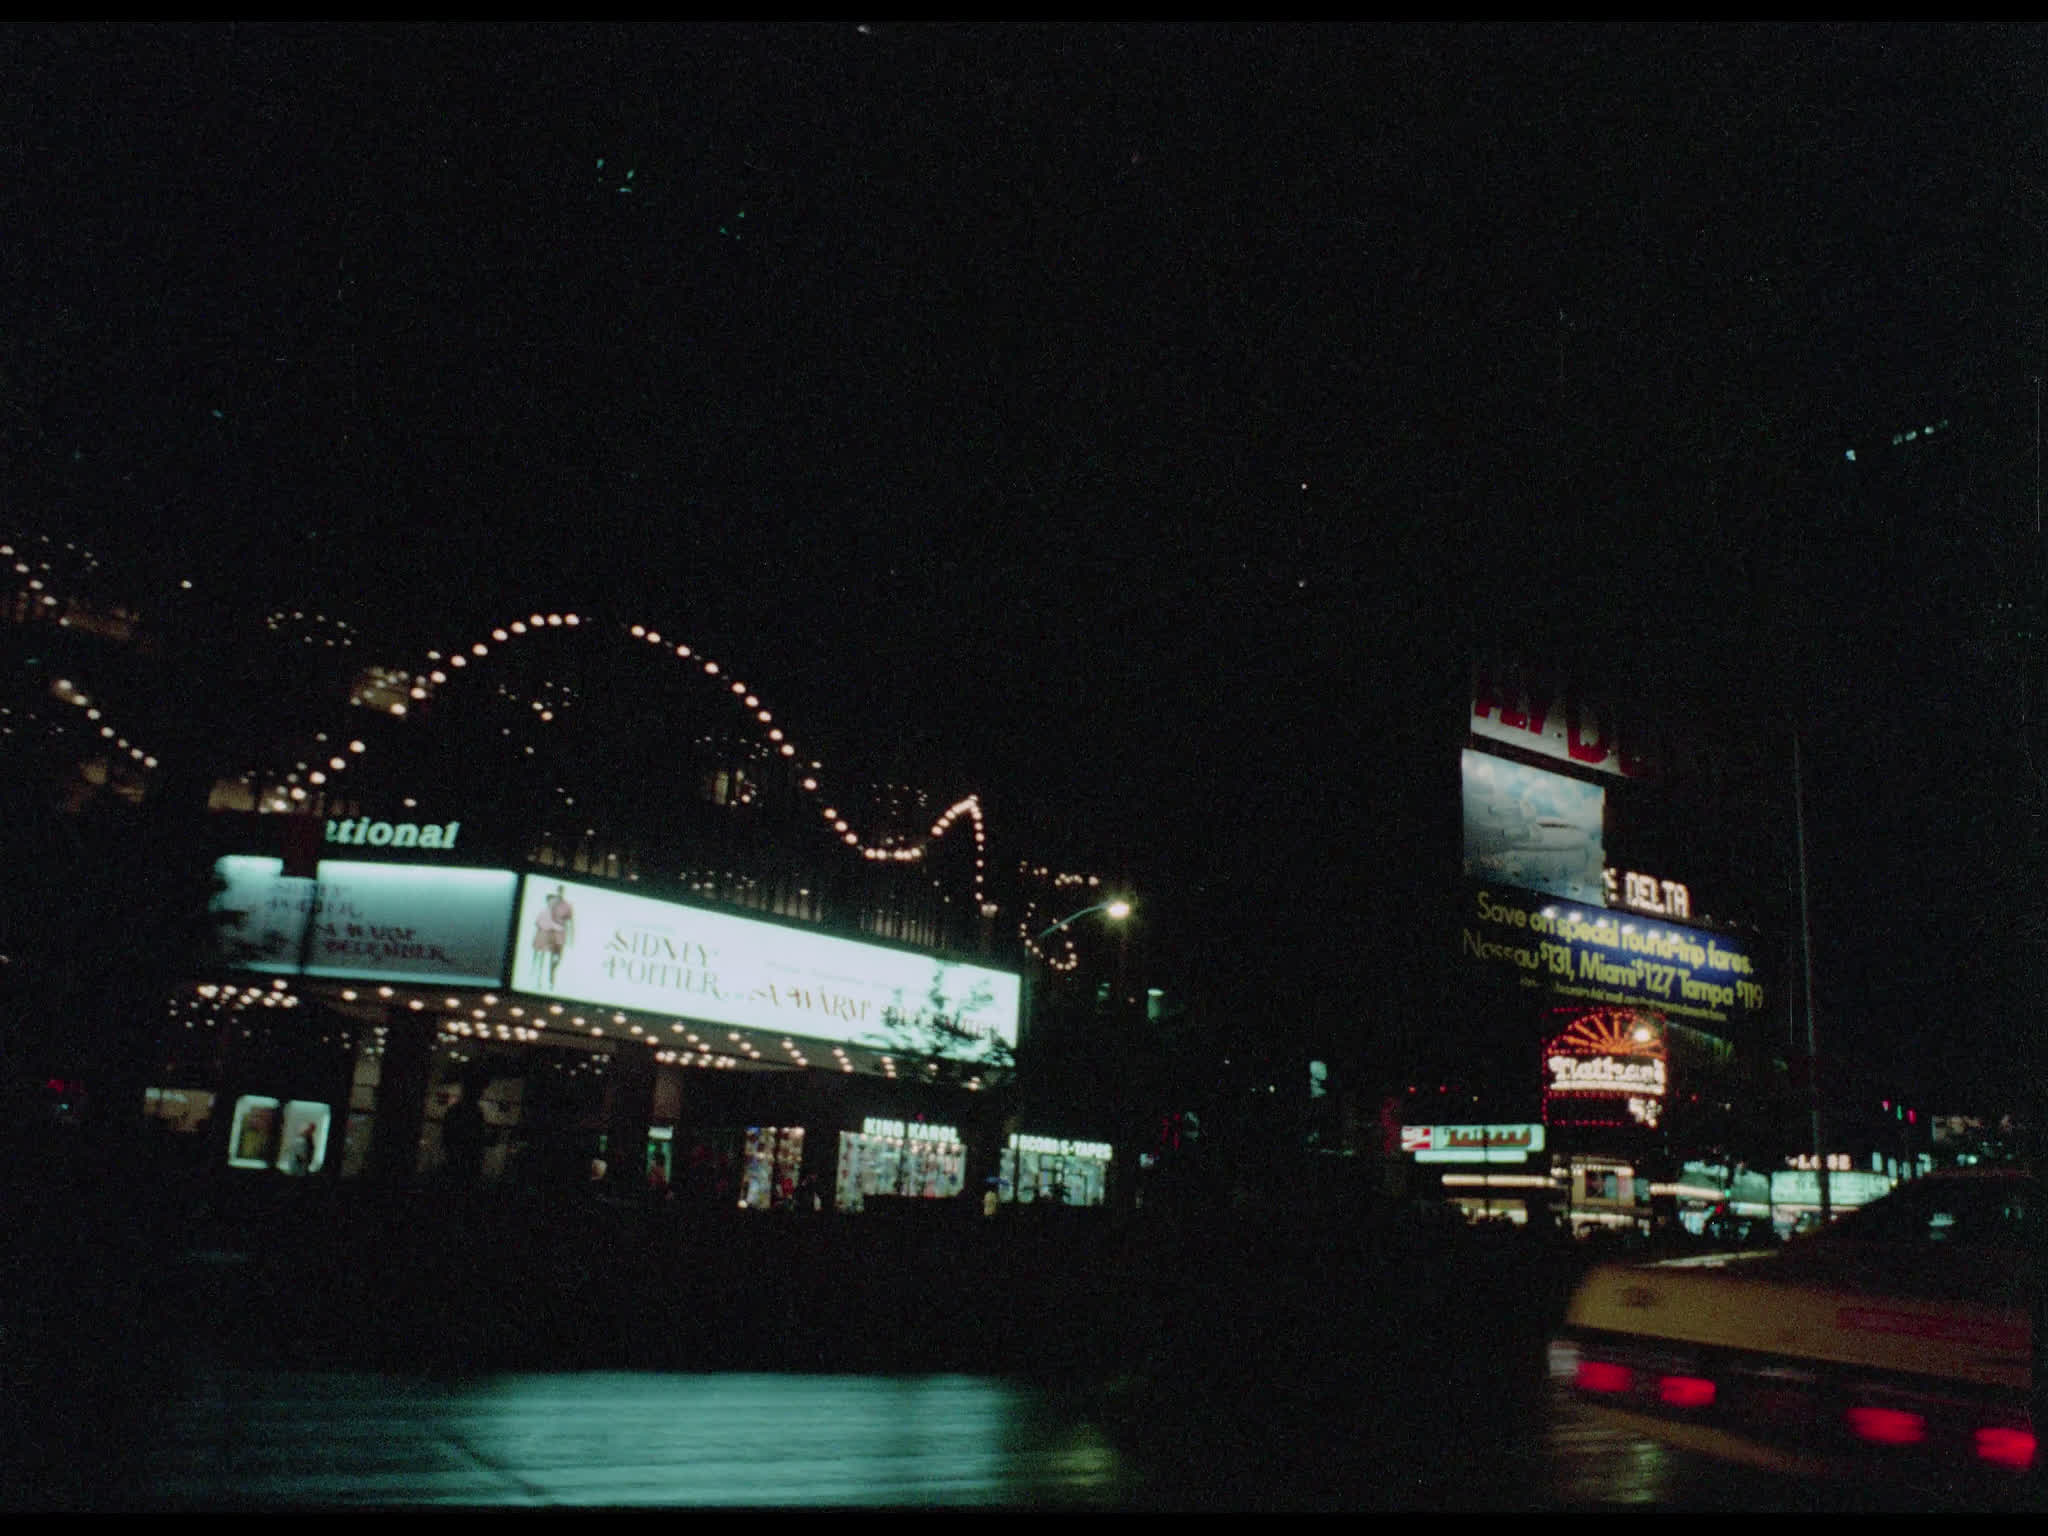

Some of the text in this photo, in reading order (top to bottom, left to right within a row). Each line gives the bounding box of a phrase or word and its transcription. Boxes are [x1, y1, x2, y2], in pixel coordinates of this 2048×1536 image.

[1626, 872, 1689, 918] DELTA
[1477, 891, 1527, 929] Save
[1529, 911, 1554, 936] on
[1556, 918, 1620, 947] special
[604, 928, 719, 968] SIDNEY
[1580, 950, 1637, 988] Miami
[1678, 970, 1735, 1009] Tampa
[786, 984, 872, 1022] WARM
